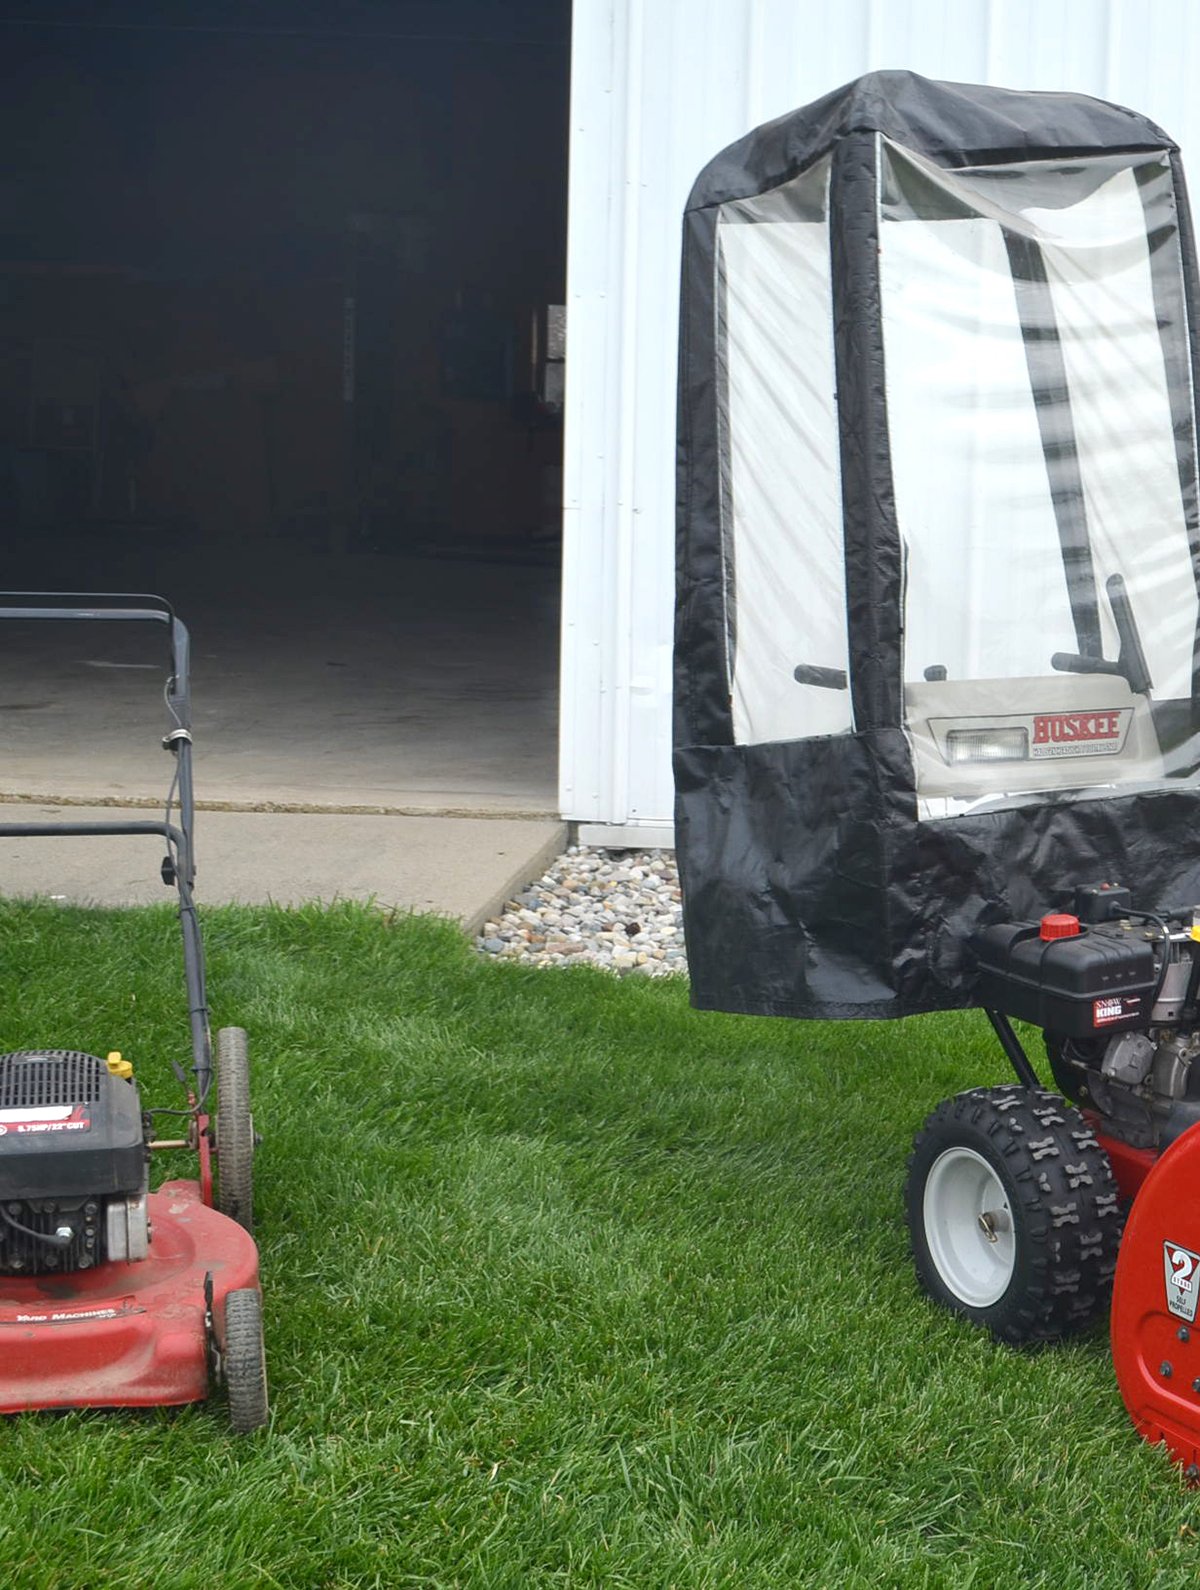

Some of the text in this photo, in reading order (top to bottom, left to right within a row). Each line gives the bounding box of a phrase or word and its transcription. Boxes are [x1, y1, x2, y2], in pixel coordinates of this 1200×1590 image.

[1033, 711, 1121, 744] HUSKEE
[1096, 1005, 1122, 1018] KING
[1171, 1250, 1193, 1292] 2
